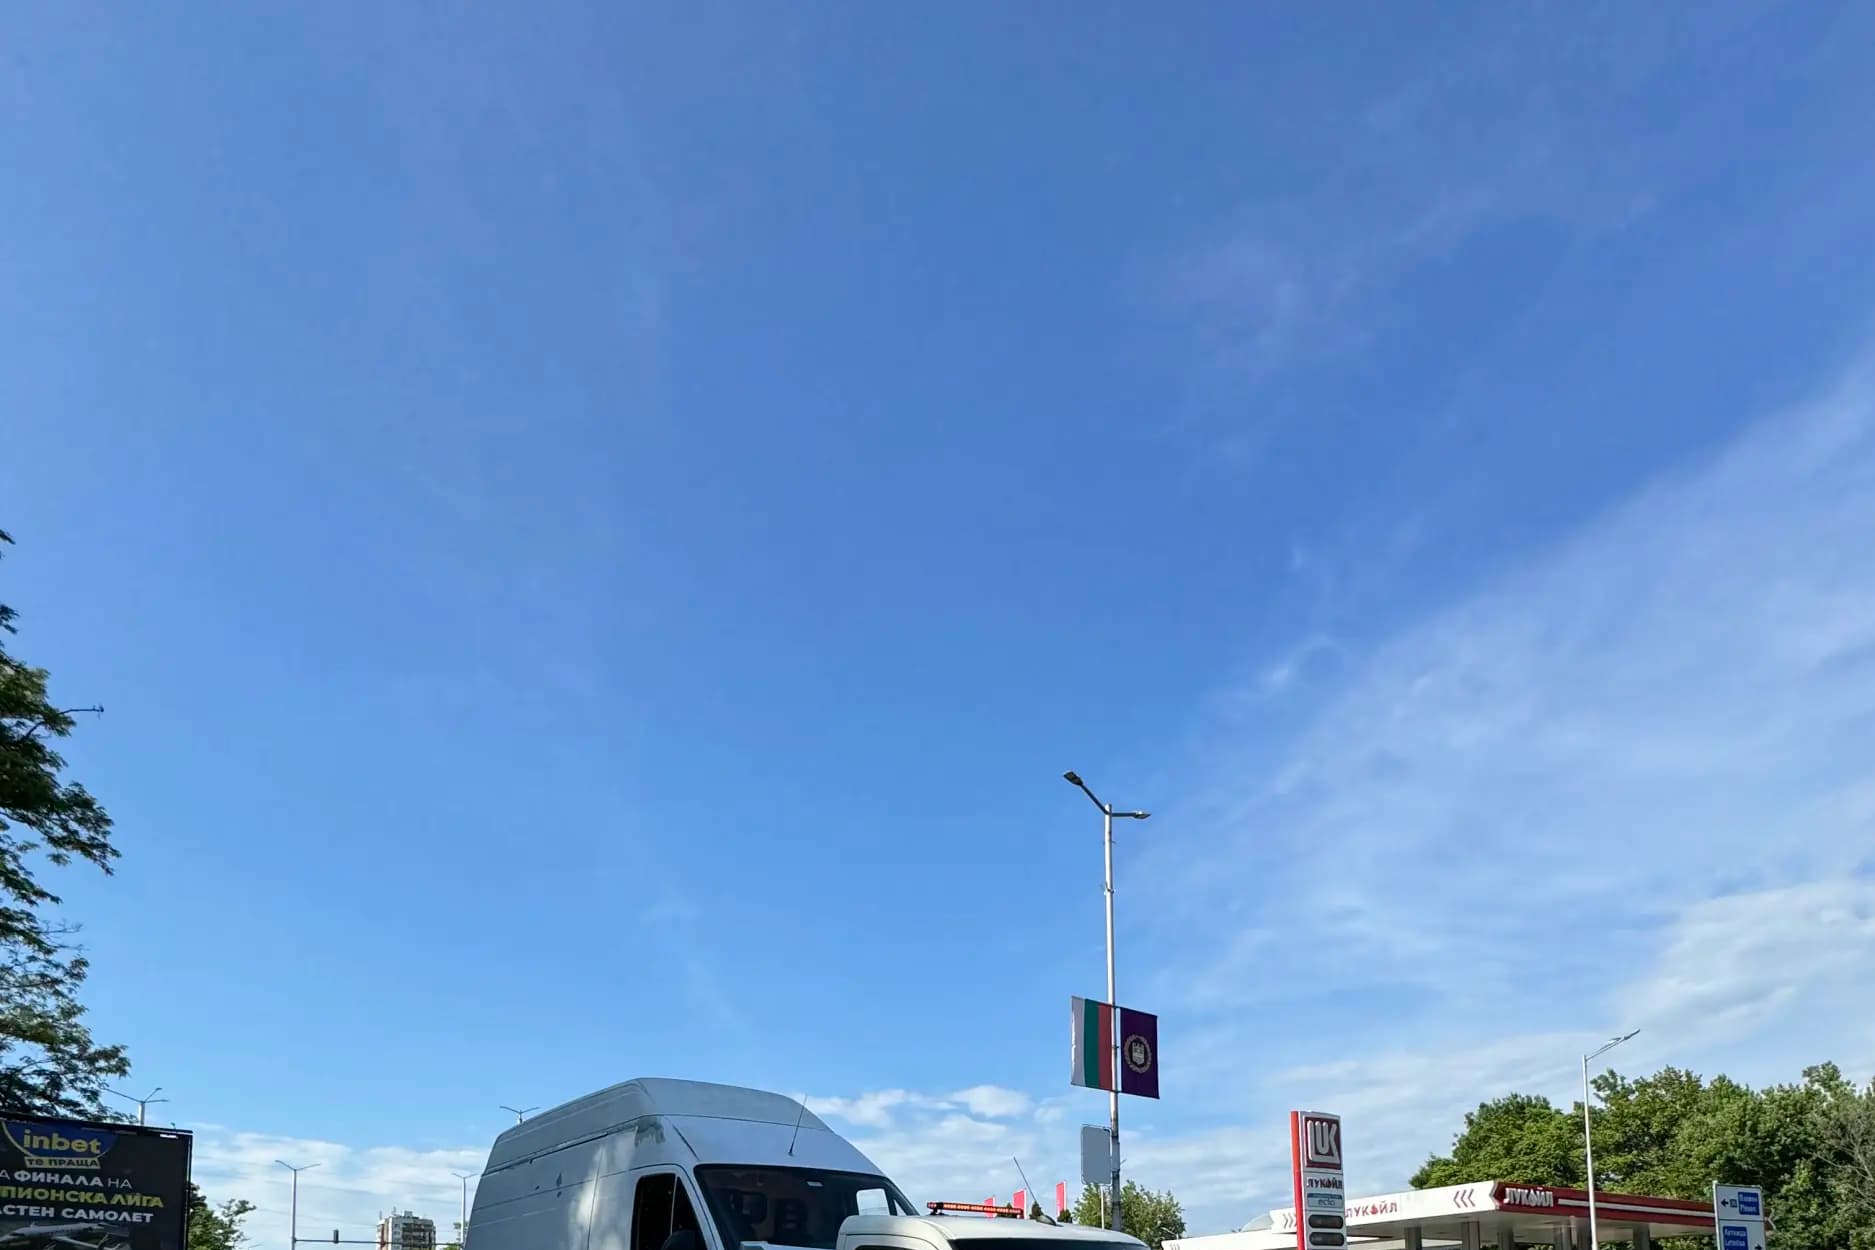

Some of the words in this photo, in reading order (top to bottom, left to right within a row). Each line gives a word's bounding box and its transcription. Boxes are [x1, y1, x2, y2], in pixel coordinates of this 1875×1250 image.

[23, 1128, 102, 1154] inbet
[49, 1158, 99, 1168] ПРАЩА
[14, 1170, 103, 1187] ФИНАЛА
[107, 1177, 133, 1190] НА
[1306, 1176, 1343, 1189] ЛУКОЙЛ
[0, 1186, 108, 1204] ПИОНСКА
[110, 1192, 165, 1208] ЛИГА
[1503, 1187, 1554, 1208] ЛУКОЙЛ
[61, 1207, 154, 1223] САМОЛЕТ
[1345, 1200, 1398, 1218] ЛУКОЙЛ
